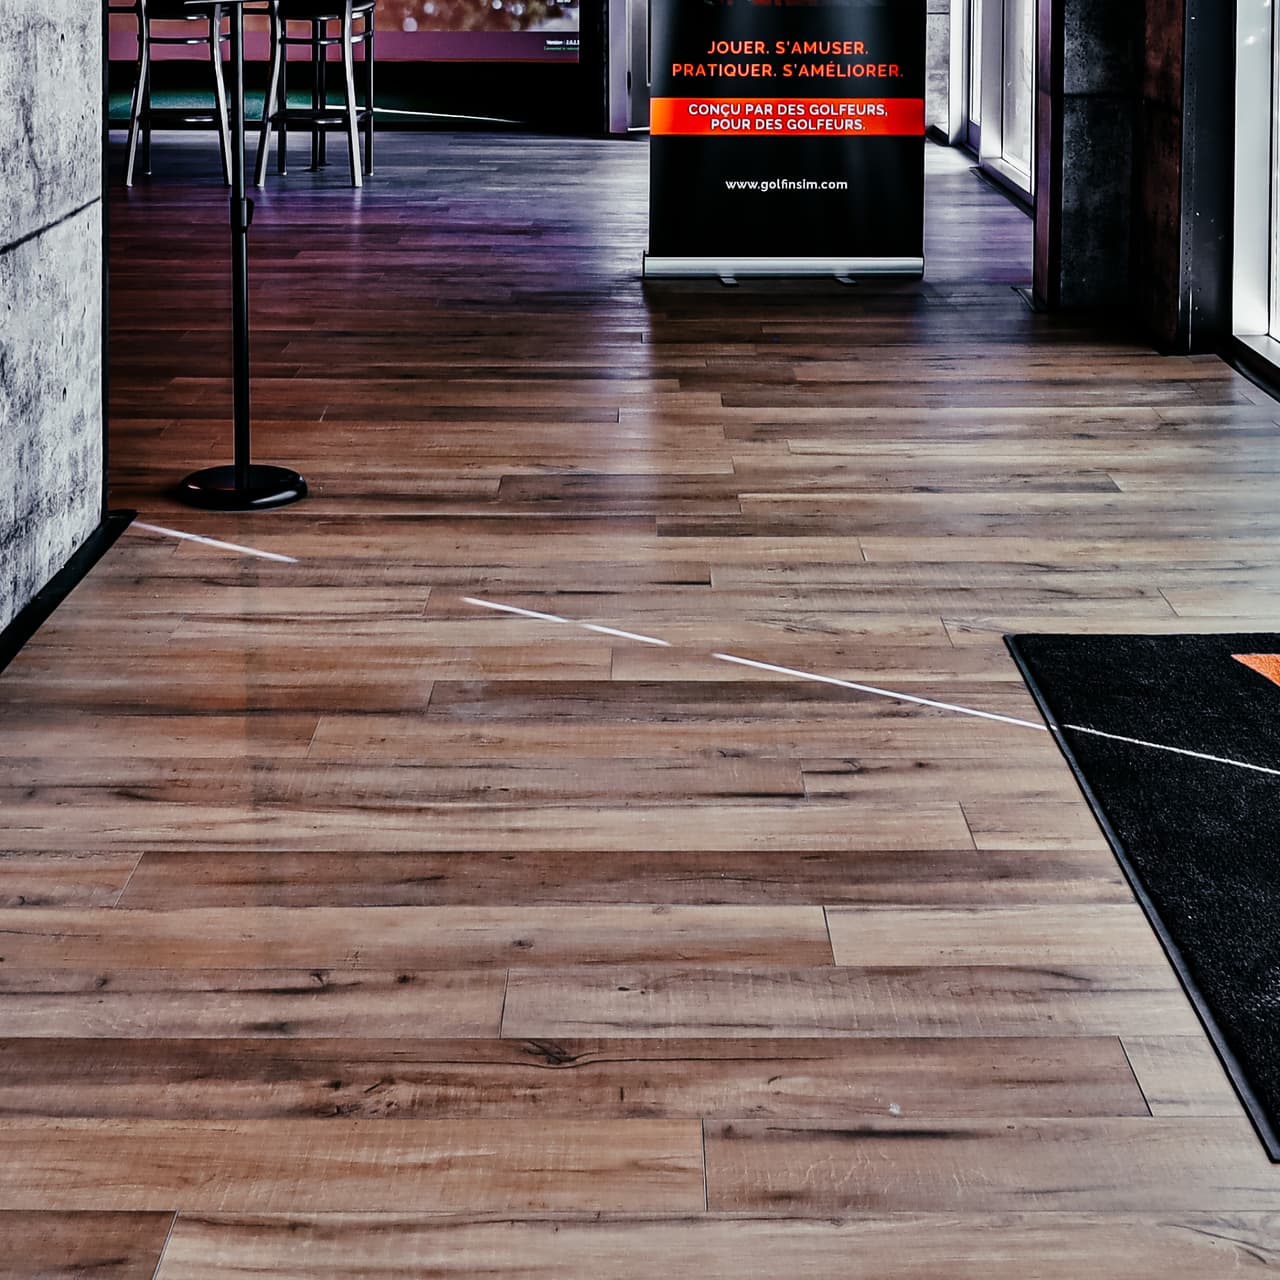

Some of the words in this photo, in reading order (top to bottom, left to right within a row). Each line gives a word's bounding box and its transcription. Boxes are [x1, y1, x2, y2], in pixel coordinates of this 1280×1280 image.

[707, 40, 770, 55] JOUER.
[775, 40, 869, 55] S'AMUSER.
[672, 63, 777, 78] PRATIQUER.
[782, 60, 904, 78] S'AMÉLIORER.
[689, 103, 741, 117] CONÇU
[745, 103, 773, 116] PAR
[778, 103, 805, 116] DES
[809, 103, 888, 117] GOLFEURS,
[711, 118, 751, 130] POUR
[755, 118, 783, 130] DES
[787, 118, 866, 130] GOLFEURS.
[725, 178, 848, 192] www.golfinsim.com
